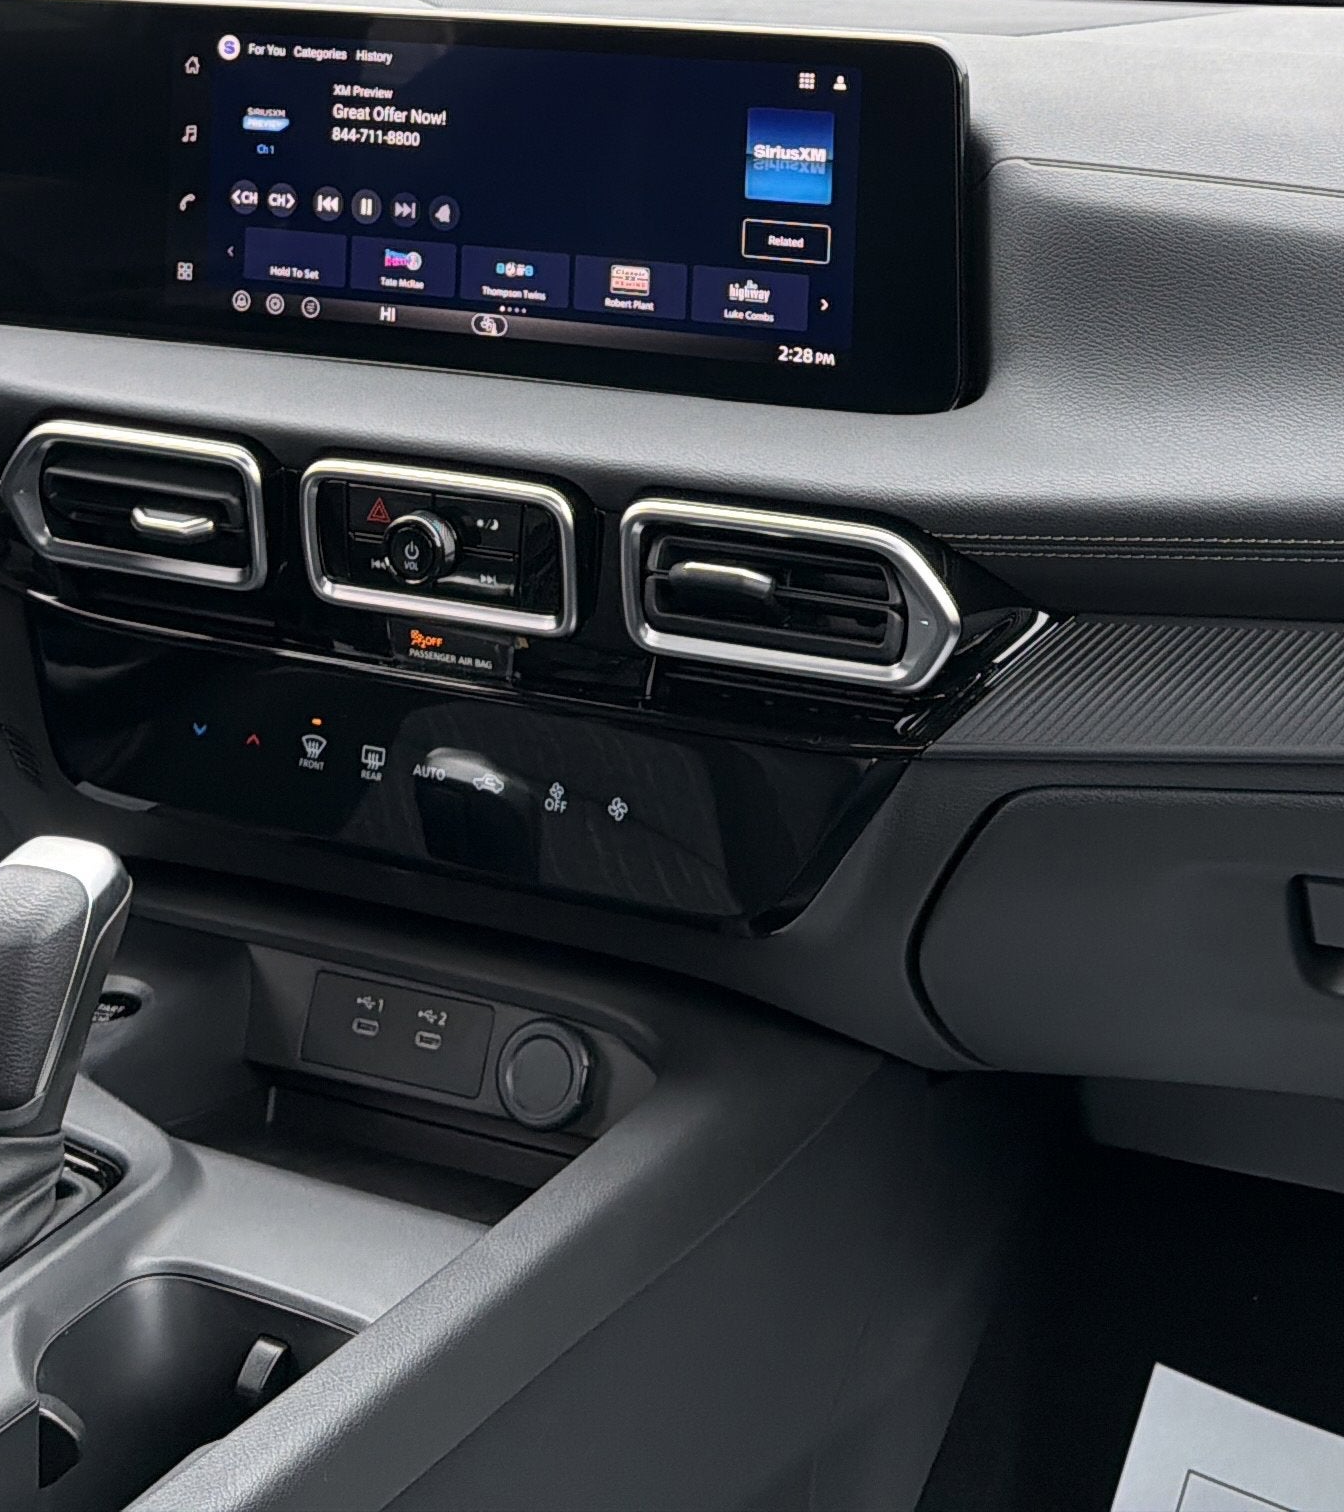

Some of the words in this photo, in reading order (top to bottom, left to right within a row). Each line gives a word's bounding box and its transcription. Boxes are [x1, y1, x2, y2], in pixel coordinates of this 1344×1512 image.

[248, 43, 265, 56] For
[266, 44, 286, 57] You
[293, 45, 348, 61] Categories
[356, 50, 393, 65] History
[333, 84, 351, 96] XM
[353, 85, 393, 99] Preview
[333, 103, 370, 121] Great
[373, 105, 407, 123] Offer
[410, 108, 447, 125] Now!
[332, 127, 421, 147] 844-711-8800
[257, 144, 268, 155] Ch
[753, 144, 827, 163] SiriusXM
[768, 235, 805, 248] Related
[269, 265, 291, 278] Hold
[292, 267, 304, 279] To
[304, 268, 320, 280] Set
[380, 276, 397, 287] Tate
[398, 278, 425, 290] McRae
[482, 285, 521, 300] Thompson
[522, 290, 547, 302] Twins
[729, 285, 771, 303] highway
[605, 297, 632, 310] Robert
[632, 299, 655, 312] Plant
[379, 306, 396, 322] HI
[723, 309, 744, 320] Luke
[745, 310, 775, 322] Combs
[777, 345, 814, 364] 2:28
[815, 352, 836, 366] PM
[404, 560, 419, 572] VOL
[425, 635, 444, 648] OFF
[409, 647, 457, 664] PASSENGER
[457, 655, 474, 667] AIR
[474, 657, 493, 670] BAG
[299, 758, 324, 771] FRONT
[413, 763, 446, 781] AUTO
[360, 769, 383, 782] REAR
[544, 798, 568, 813] OFF
[438, 1011, 448, 1026] 2
